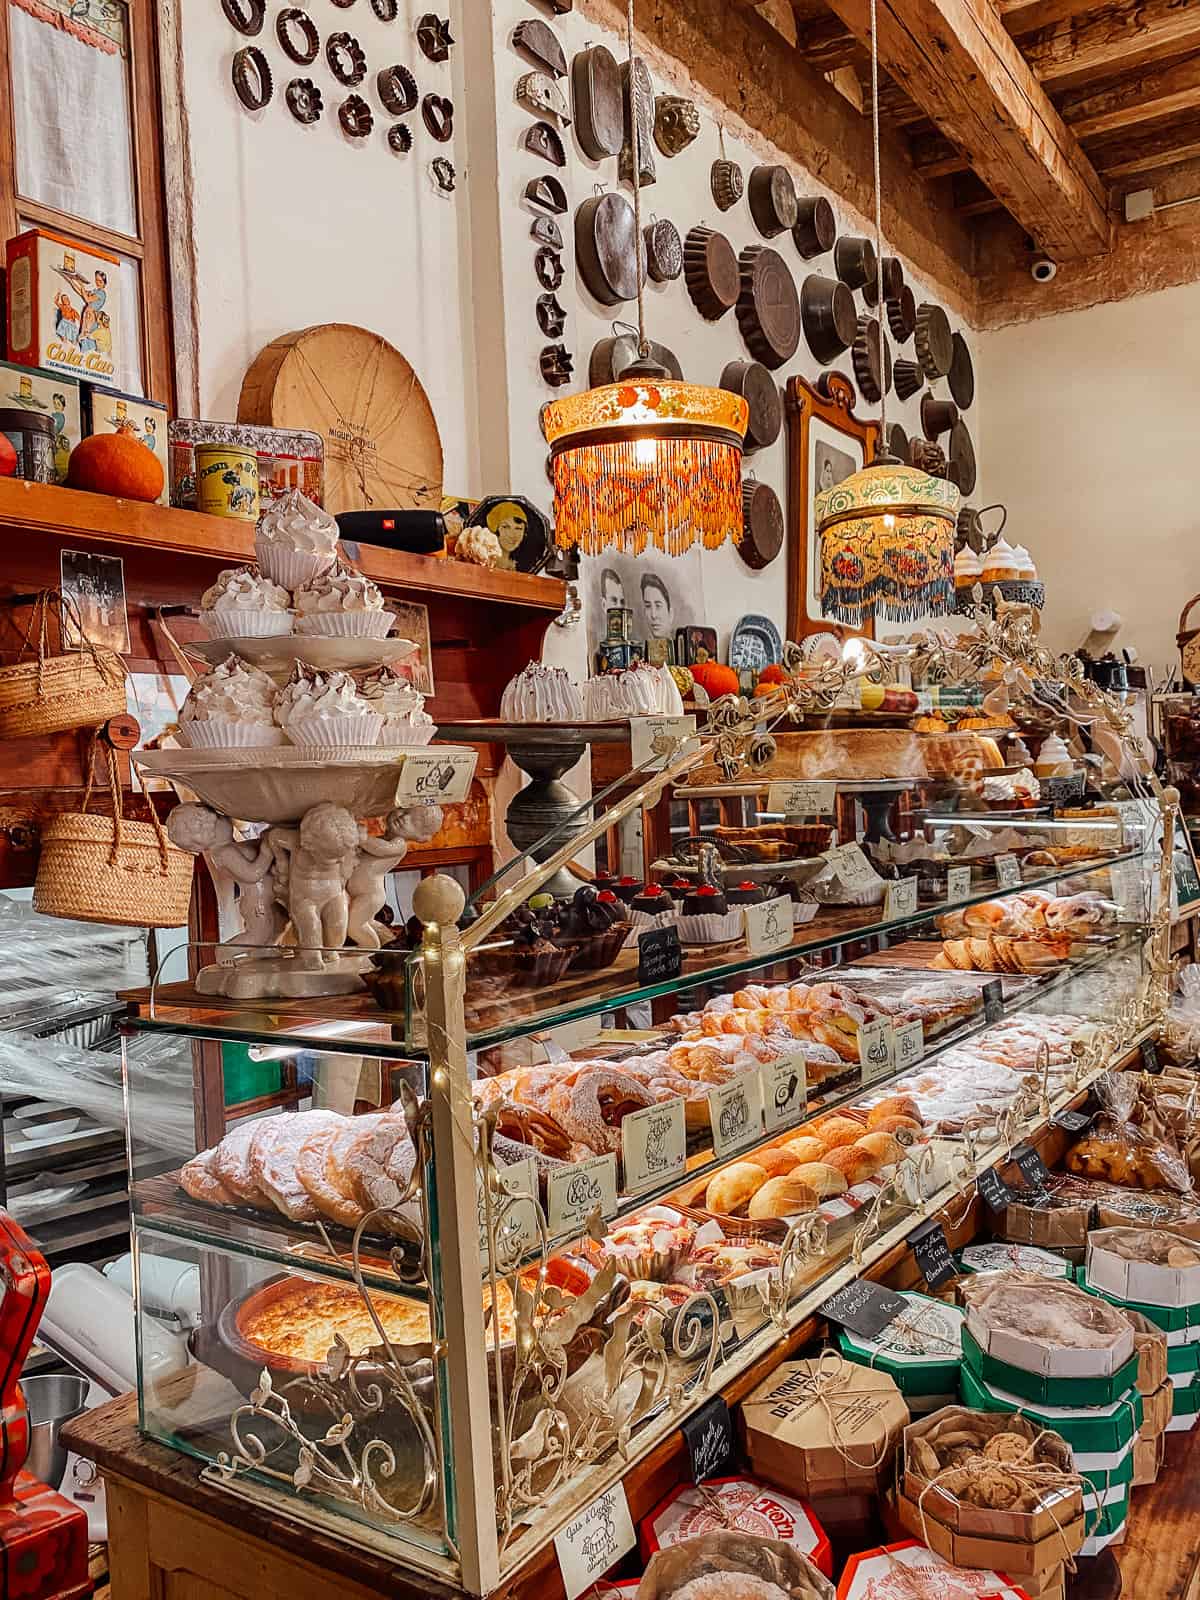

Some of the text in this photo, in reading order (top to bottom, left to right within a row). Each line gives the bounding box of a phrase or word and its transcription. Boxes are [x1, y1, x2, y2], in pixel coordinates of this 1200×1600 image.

[46, 342, 83, 367] Cola
[85, 352, 114, 375] Cao
[770, 1404, 795, 1419] DE
